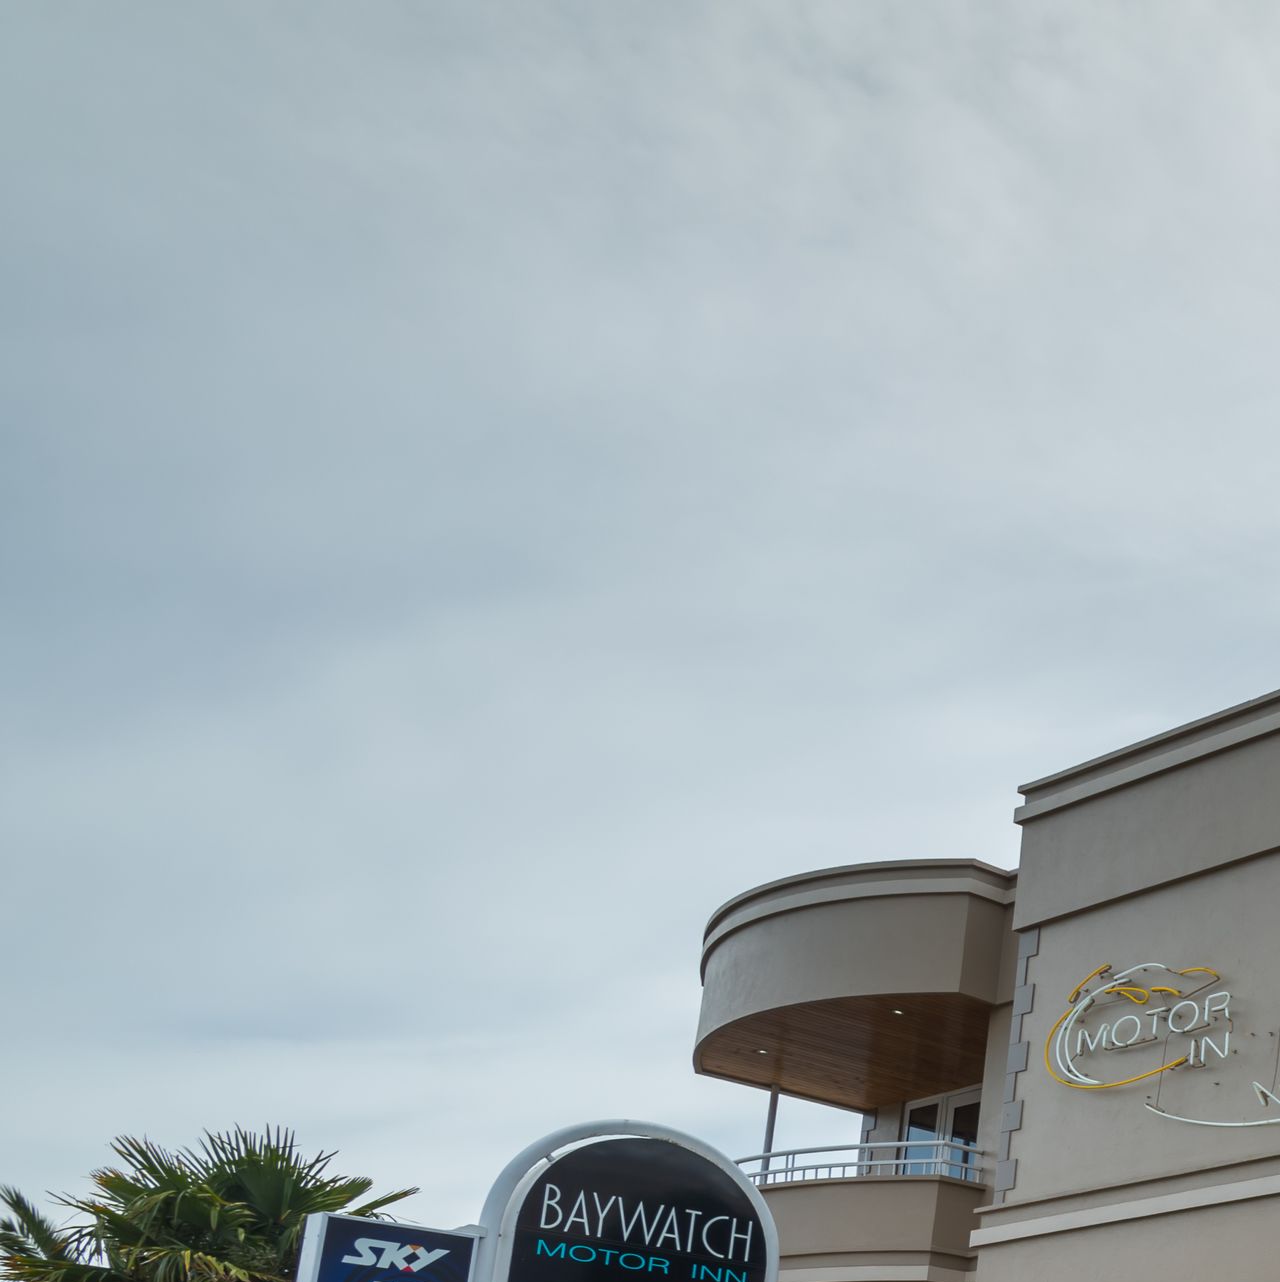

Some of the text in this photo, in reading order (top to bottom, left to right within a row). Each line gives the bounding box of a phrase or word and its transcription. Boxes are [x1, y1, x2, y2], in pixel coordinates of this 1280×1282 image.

[1076, 991, 1231, 1057] MOTOR
[540, 1182, 754, 1263] BAYWATCH
[341, 1237, 451, 1273] SKY
[535, 1239, 671, 1275] MOTOR
